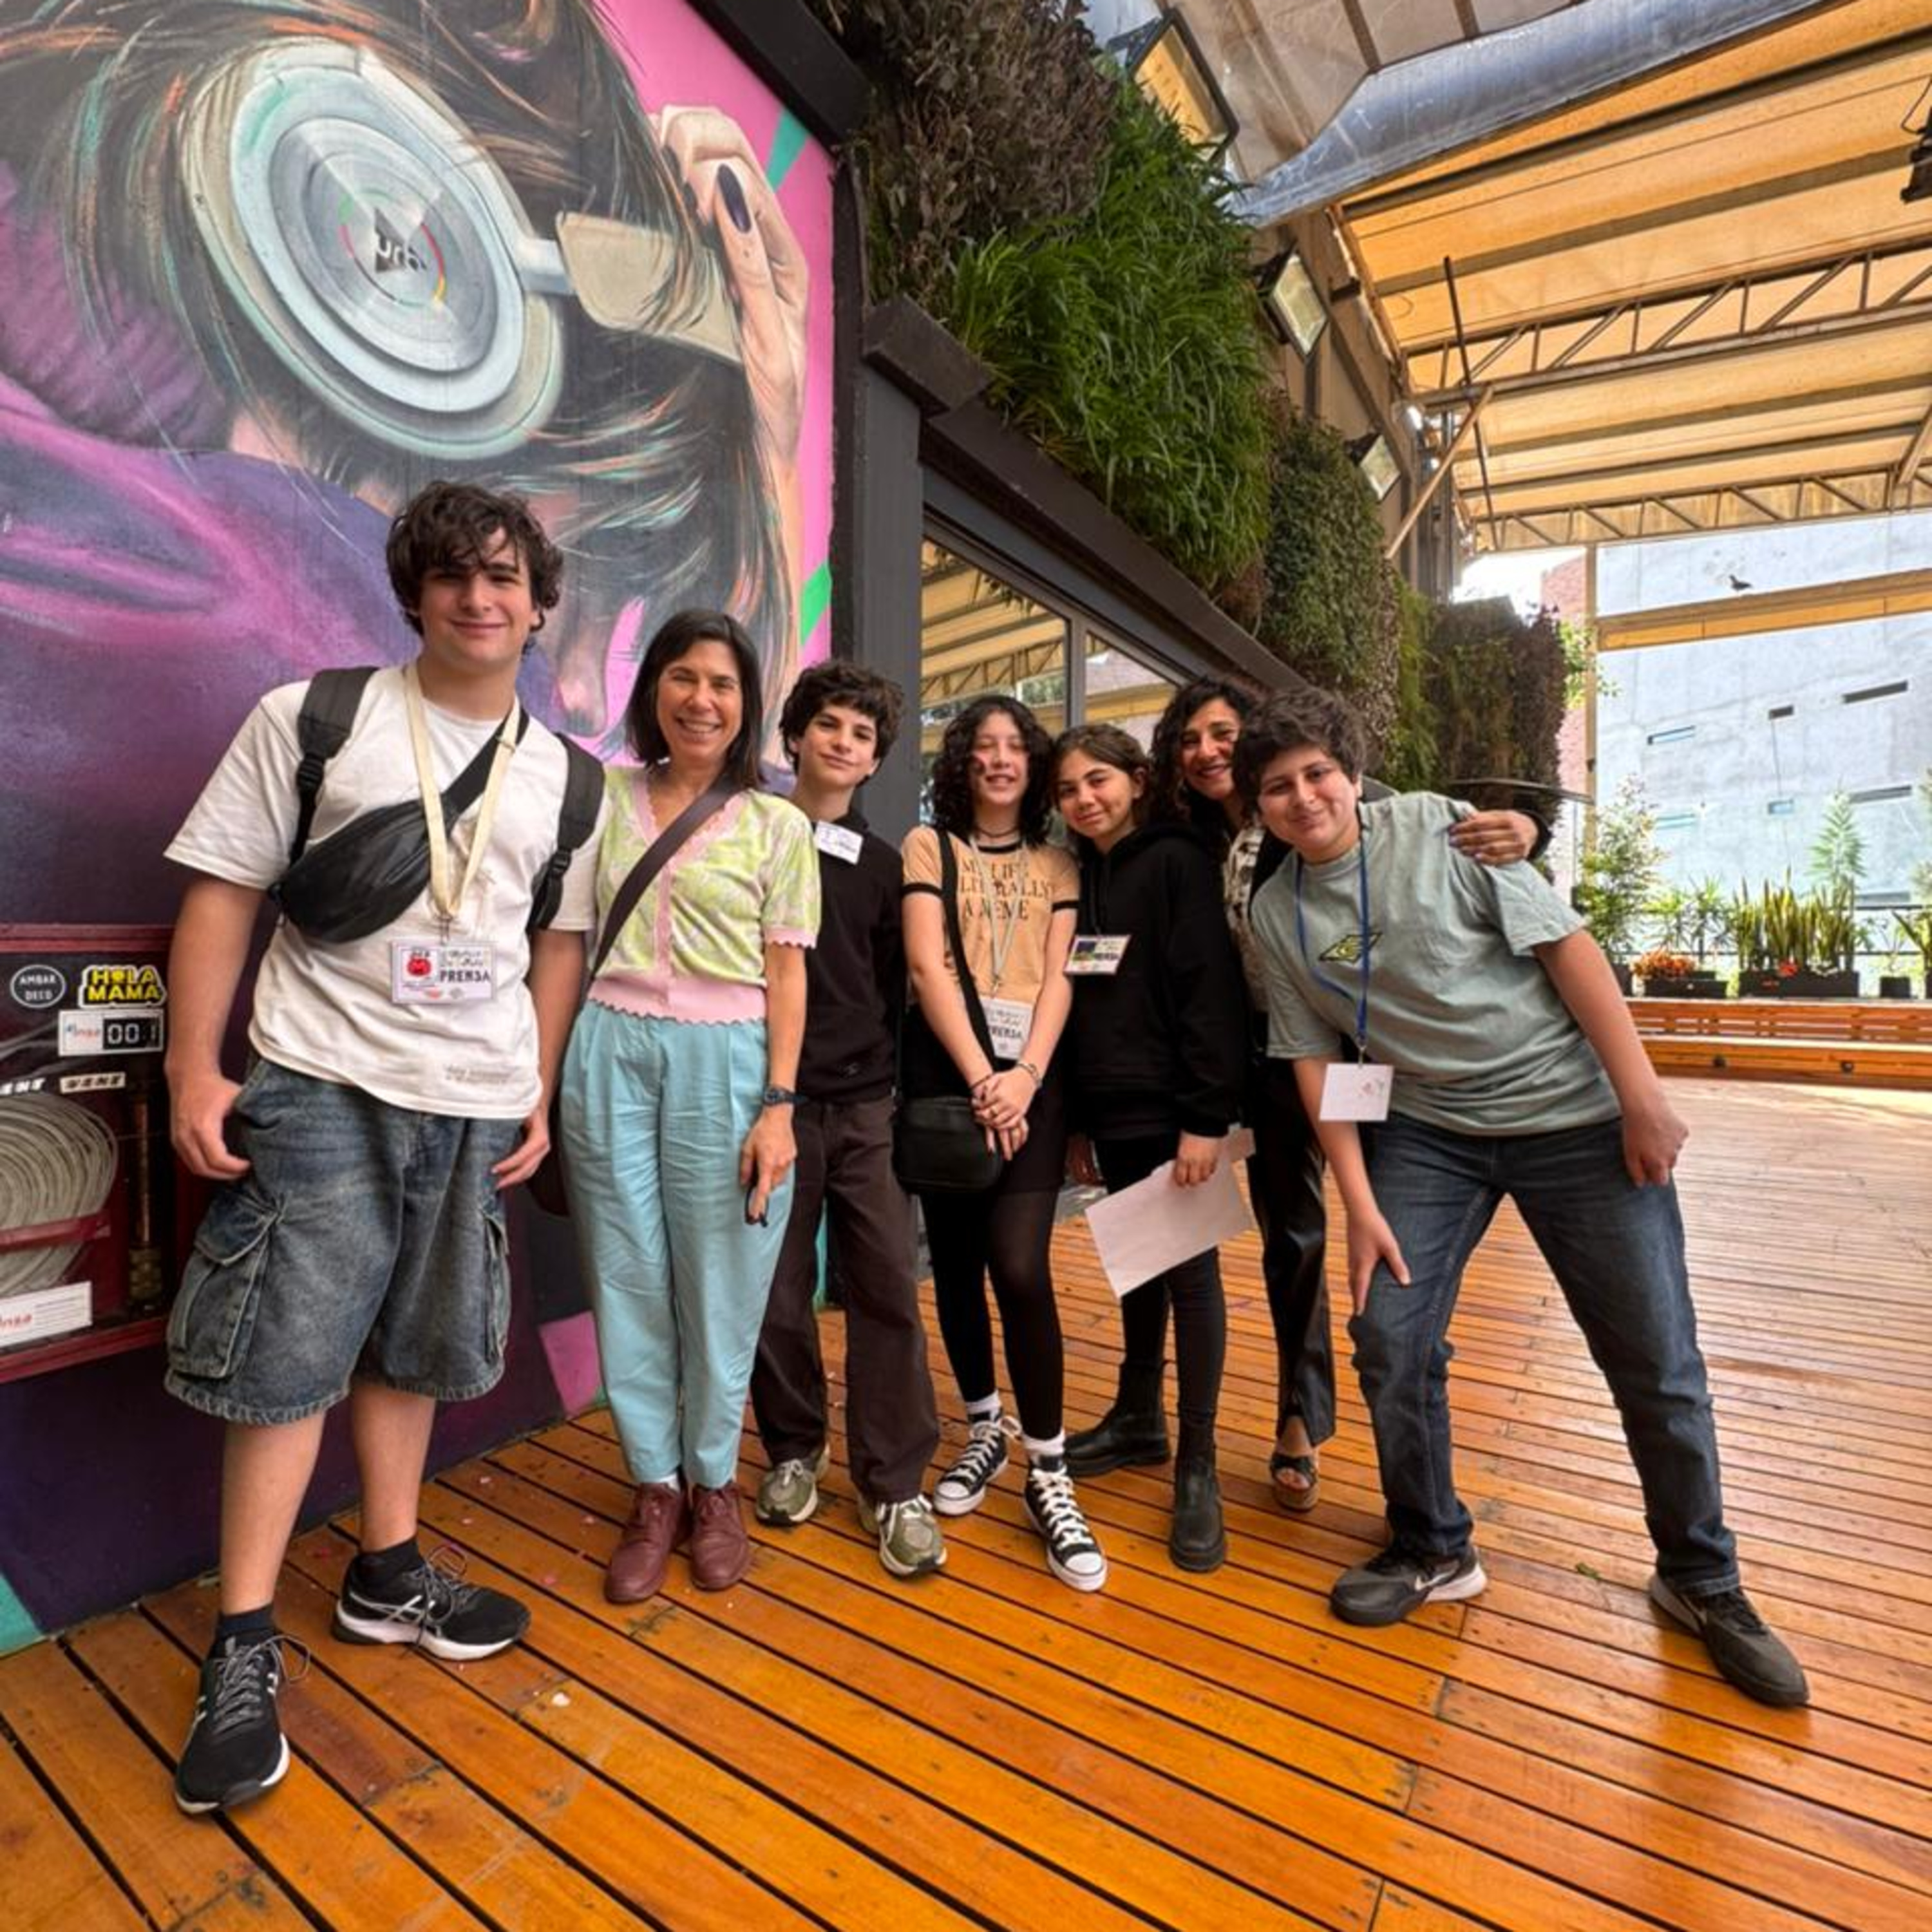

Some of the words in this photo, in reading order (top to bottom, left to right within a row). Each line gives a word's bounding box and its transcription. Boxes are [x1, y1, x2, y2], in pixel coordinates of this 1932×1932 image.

[19, 974, 56, 985] AMBAR
[92, 968, 155, 983] HOLA
[440, 970, 491, 982] PRENSA
[88, 985, 160, 1000] MAMA
